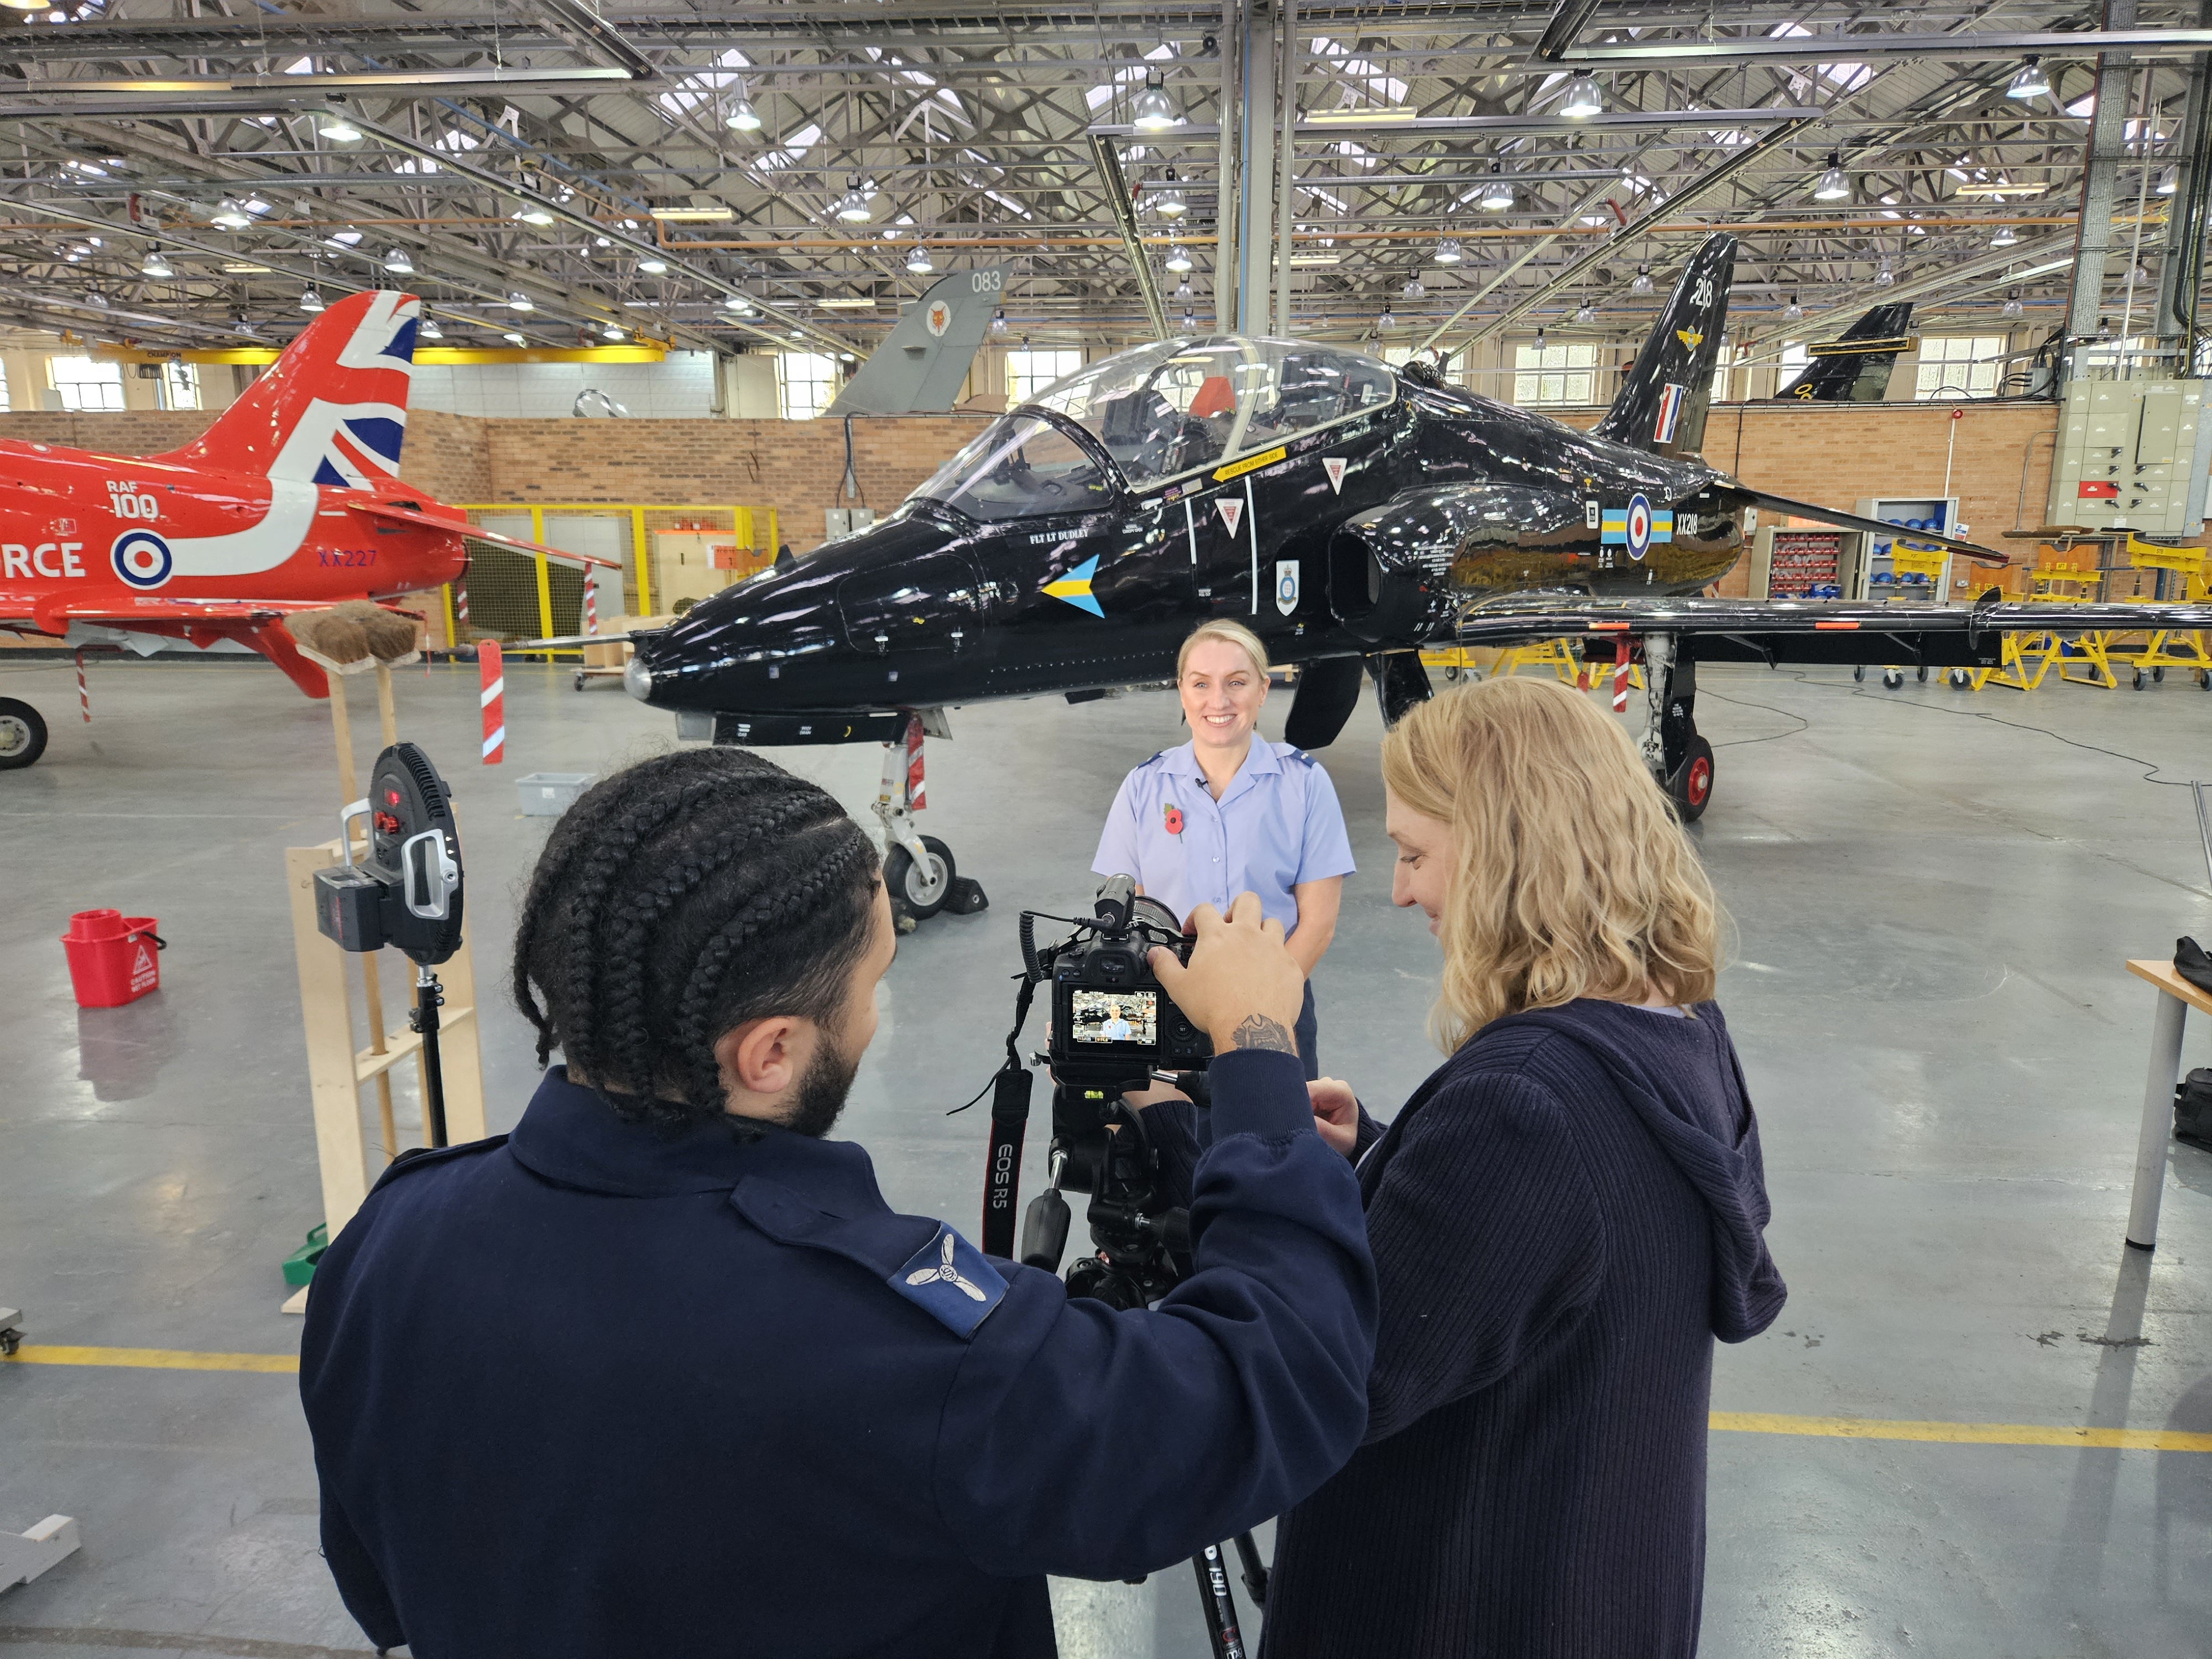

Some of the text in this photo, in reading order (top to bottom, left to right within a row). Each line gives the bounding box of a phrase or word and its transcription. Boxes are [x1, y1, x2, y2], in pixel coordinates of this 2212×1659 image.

[972, 270, 1001, 293] 083
[1694, 278, 1713, 308] 218
[1224, 452, 1279, 476] RESCUE FROM EITHER SIDE
[106, 480, 138, 493] RAF
[110, 493, 158, 519] 100
[1676, 513, 1698, 535] XX218
[1029, 529, 1089, 544] FLT LT DUDLEY
[1, 542, 86, 578] RCE
[318, 550, 377, 567] XX227
[993, 1144, 1013, 1208] EOS R5
[1209, 1566, 1227, 1596] 190
